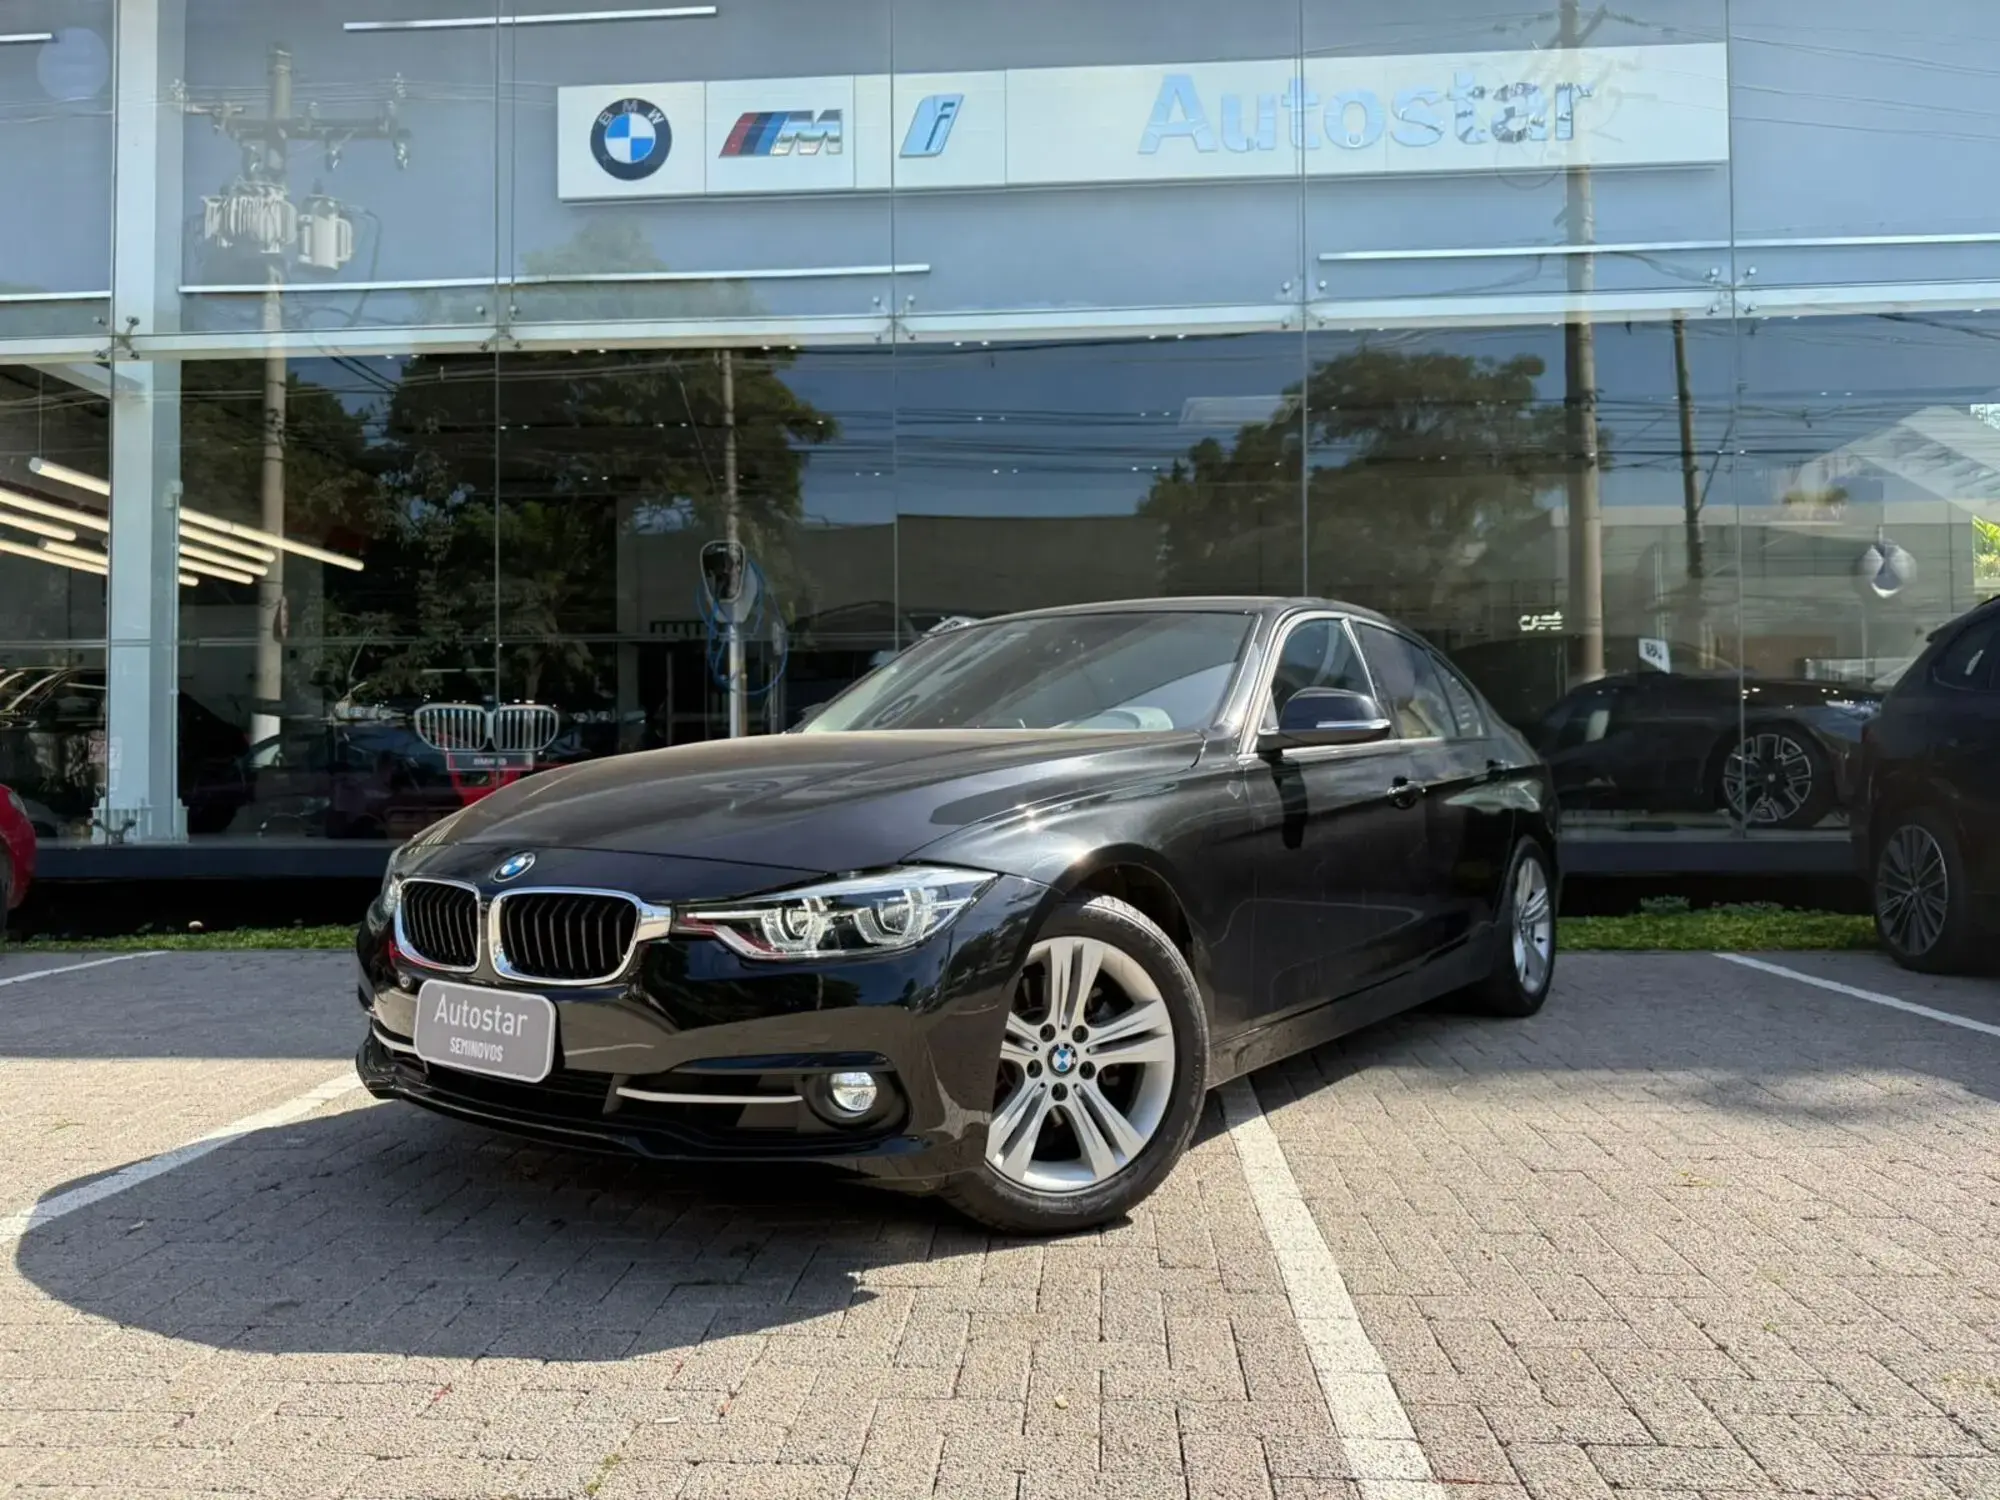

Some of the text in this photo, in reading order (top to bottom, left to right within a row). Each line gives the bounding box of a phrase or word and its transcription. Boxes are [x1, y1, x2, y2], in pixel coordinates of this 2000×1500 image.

[599, 100, 665, 126] BMW
[769, 109, 843, 156] M
[1138, 71, 1593, 154] Autostar
[434, 993, 528, 1037] Autostar
[450, 1037, 504, 1063] SEMINOVOS
